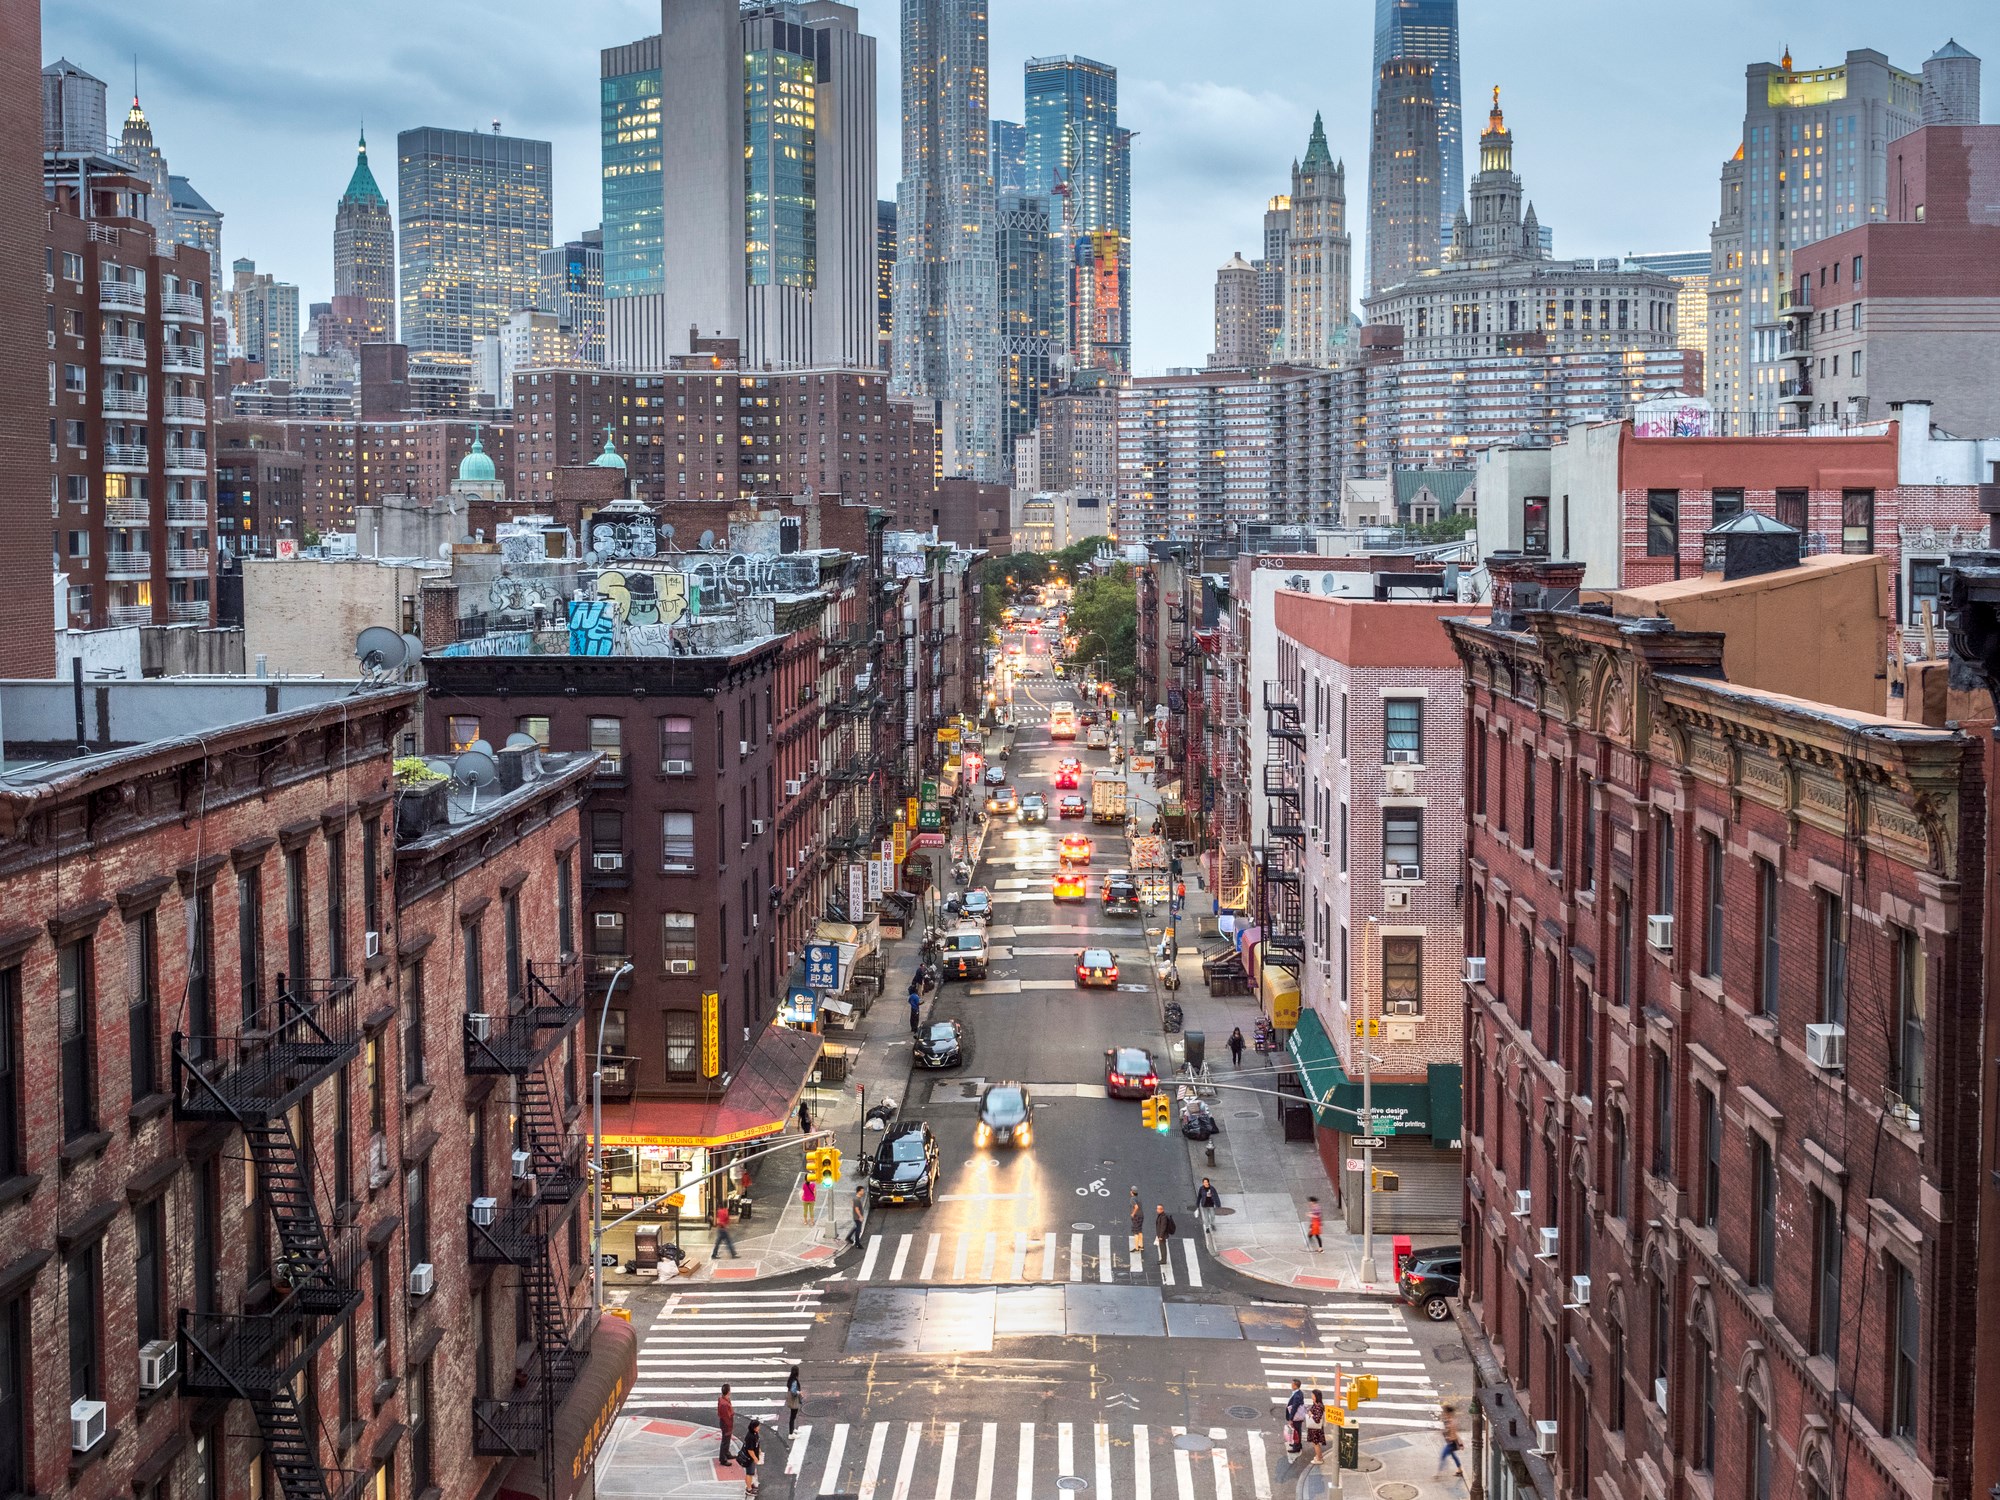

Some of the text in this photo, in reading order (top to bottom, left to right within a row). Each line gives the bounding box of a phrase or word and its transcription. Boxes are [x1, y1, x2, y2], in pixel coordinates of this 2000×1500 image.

[1404, 1121, 1426, 1129] printing
[1327, 1408, 1343, 1417] RAISE
[1327, 1413, 1343, 1423] PLOW
